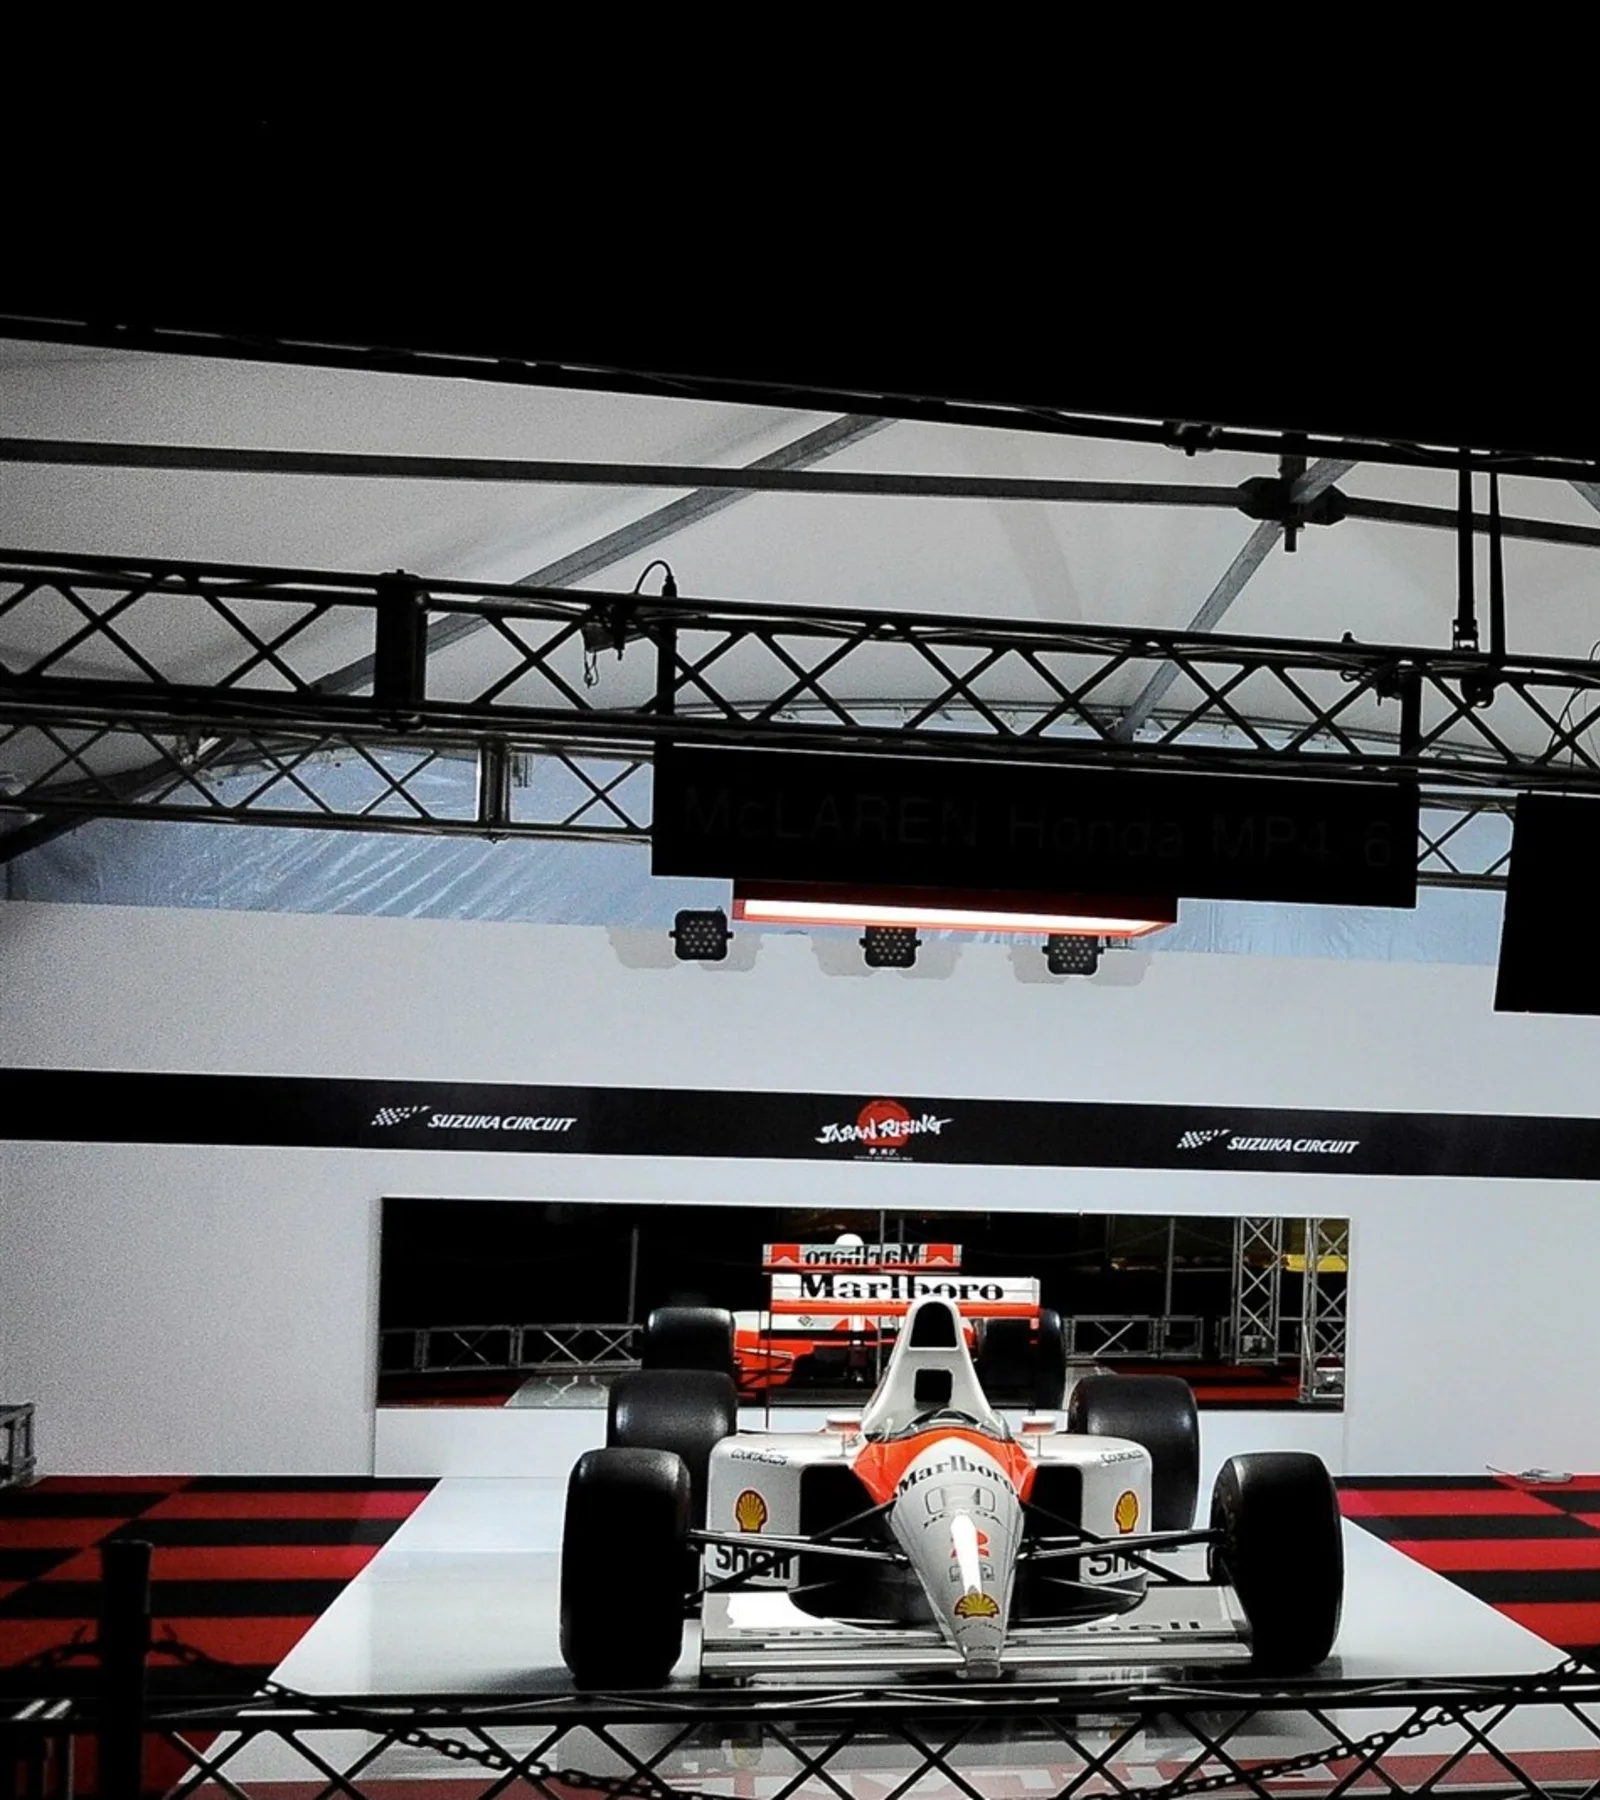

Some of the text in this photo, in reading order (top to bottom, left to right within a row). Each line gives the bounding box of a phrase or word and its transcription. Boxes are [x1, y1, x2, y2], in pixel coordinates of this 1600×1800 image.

[427, 1114, 577, 1131] SUZUKA CIRCUIT
[815, 1114, 953, 1143] JAPAN RISING
[1227, 1137, 1360, 1153] SUZUKA CIRCUIT
[800, 1274, 1004, 1300] Marlboro
[896, 1455, 1018, 1497] Marlboro
